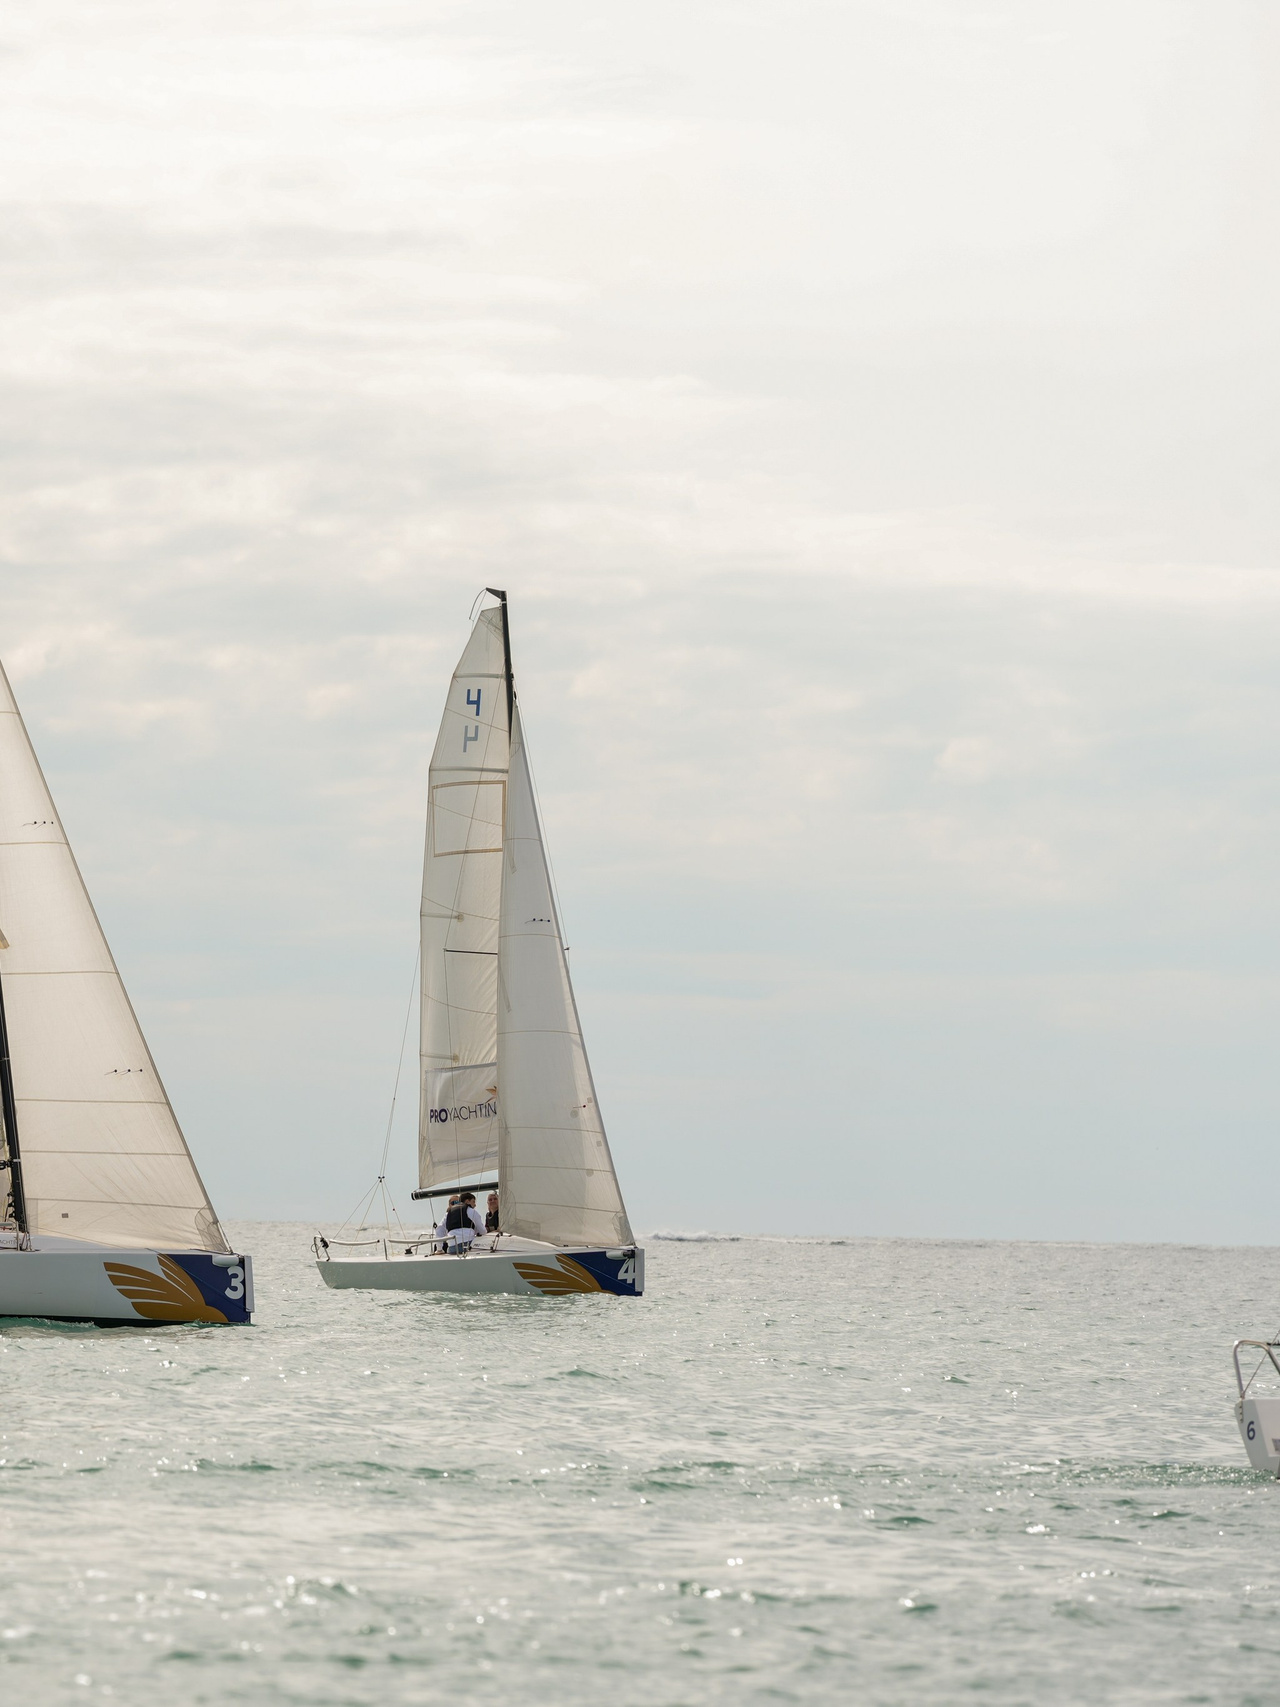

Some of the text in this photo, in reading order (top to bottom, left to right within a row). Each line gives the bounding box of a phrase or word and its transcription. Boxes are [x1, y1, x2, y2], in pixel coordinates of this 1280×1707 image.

[466, 688, 481, 716] 4
[429, 1101, 497, 1124] PROYACHTIN
[224, 1265, 245, 1300] 3
[617, 1257, 636, 1284] 4
[1246, 1420, 1256, 1441] 6
